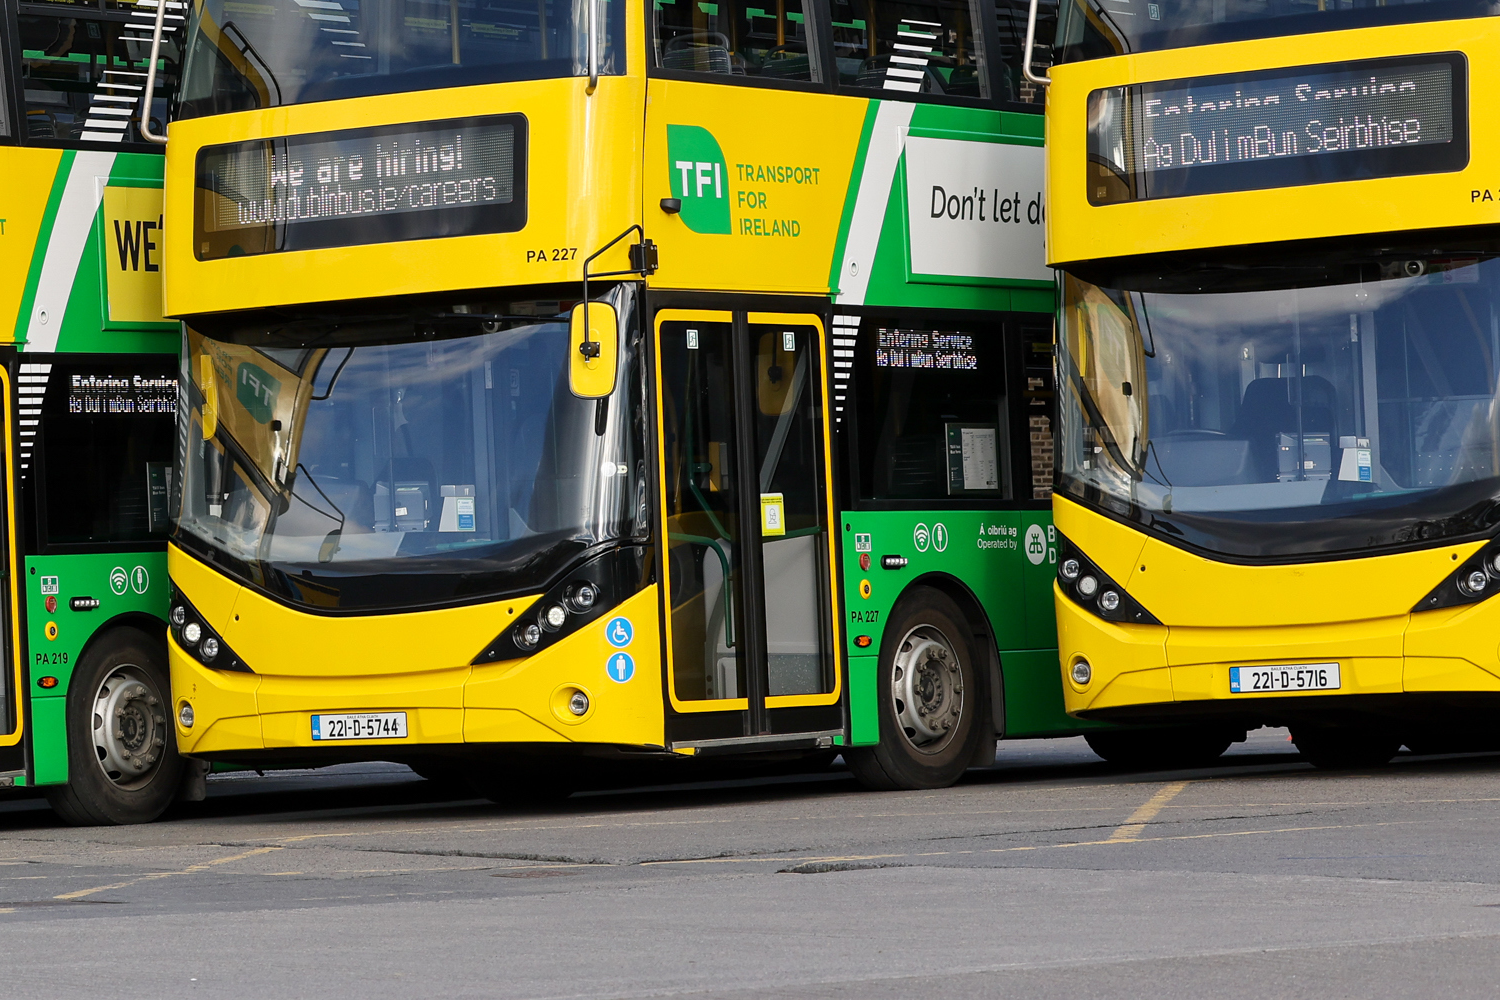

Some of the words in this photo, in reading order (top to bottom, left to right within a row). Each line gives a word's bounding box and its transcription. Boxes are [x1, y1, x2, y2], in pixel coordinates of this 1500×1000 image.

[1144, 136, 1173, 169] Ag
[1182, 132, 1216, 165] Dul
[1224, 130, 1230, 160] i
[1238, 126, 1297, 159] mBun
[271, 153, 304, 188] We
[316, 154, 363, 184] are
[376, 134, 463, 177] hiring!
[675, 160, 722, 199] TFI
[736, 164, 820, 186] TRANSPORT
[238, 176, 496, 225] www.dublinbus.ie/careers
[738, 191, 768, 210] FOR
[1471, 189, 1494, 202] PA
[993, 188, 1020, 224] let
[739, 218, 800, 237] IRELAND
[526, 250, 547, 262] PA
[552, 248, 577, 262] 227
[878, 328, 928, 348] Entering
[932, 330, 972, 350] Service
[876, 348, 888, 366] Ag
[72, 374, 130, 393] Entering
[133, 374, 178, 393] Service
[70, 395, 82, 412] Ag
[979, 522, 986, 535] Á
[1008, 527, 1017, 537] ag
[977, 538, 1008, 550] Operated
[1010, 538, 1018, 550] by
[851, 611, 864, 624] PA
[865, 610, 879, 622] 227
[36, 654, 50, 665] PA
[52, 652, 68, 664] 219
[1252, 670, 1328, 690] 221-D-5716
[328, 718, 398, 738] 221-D-5744
